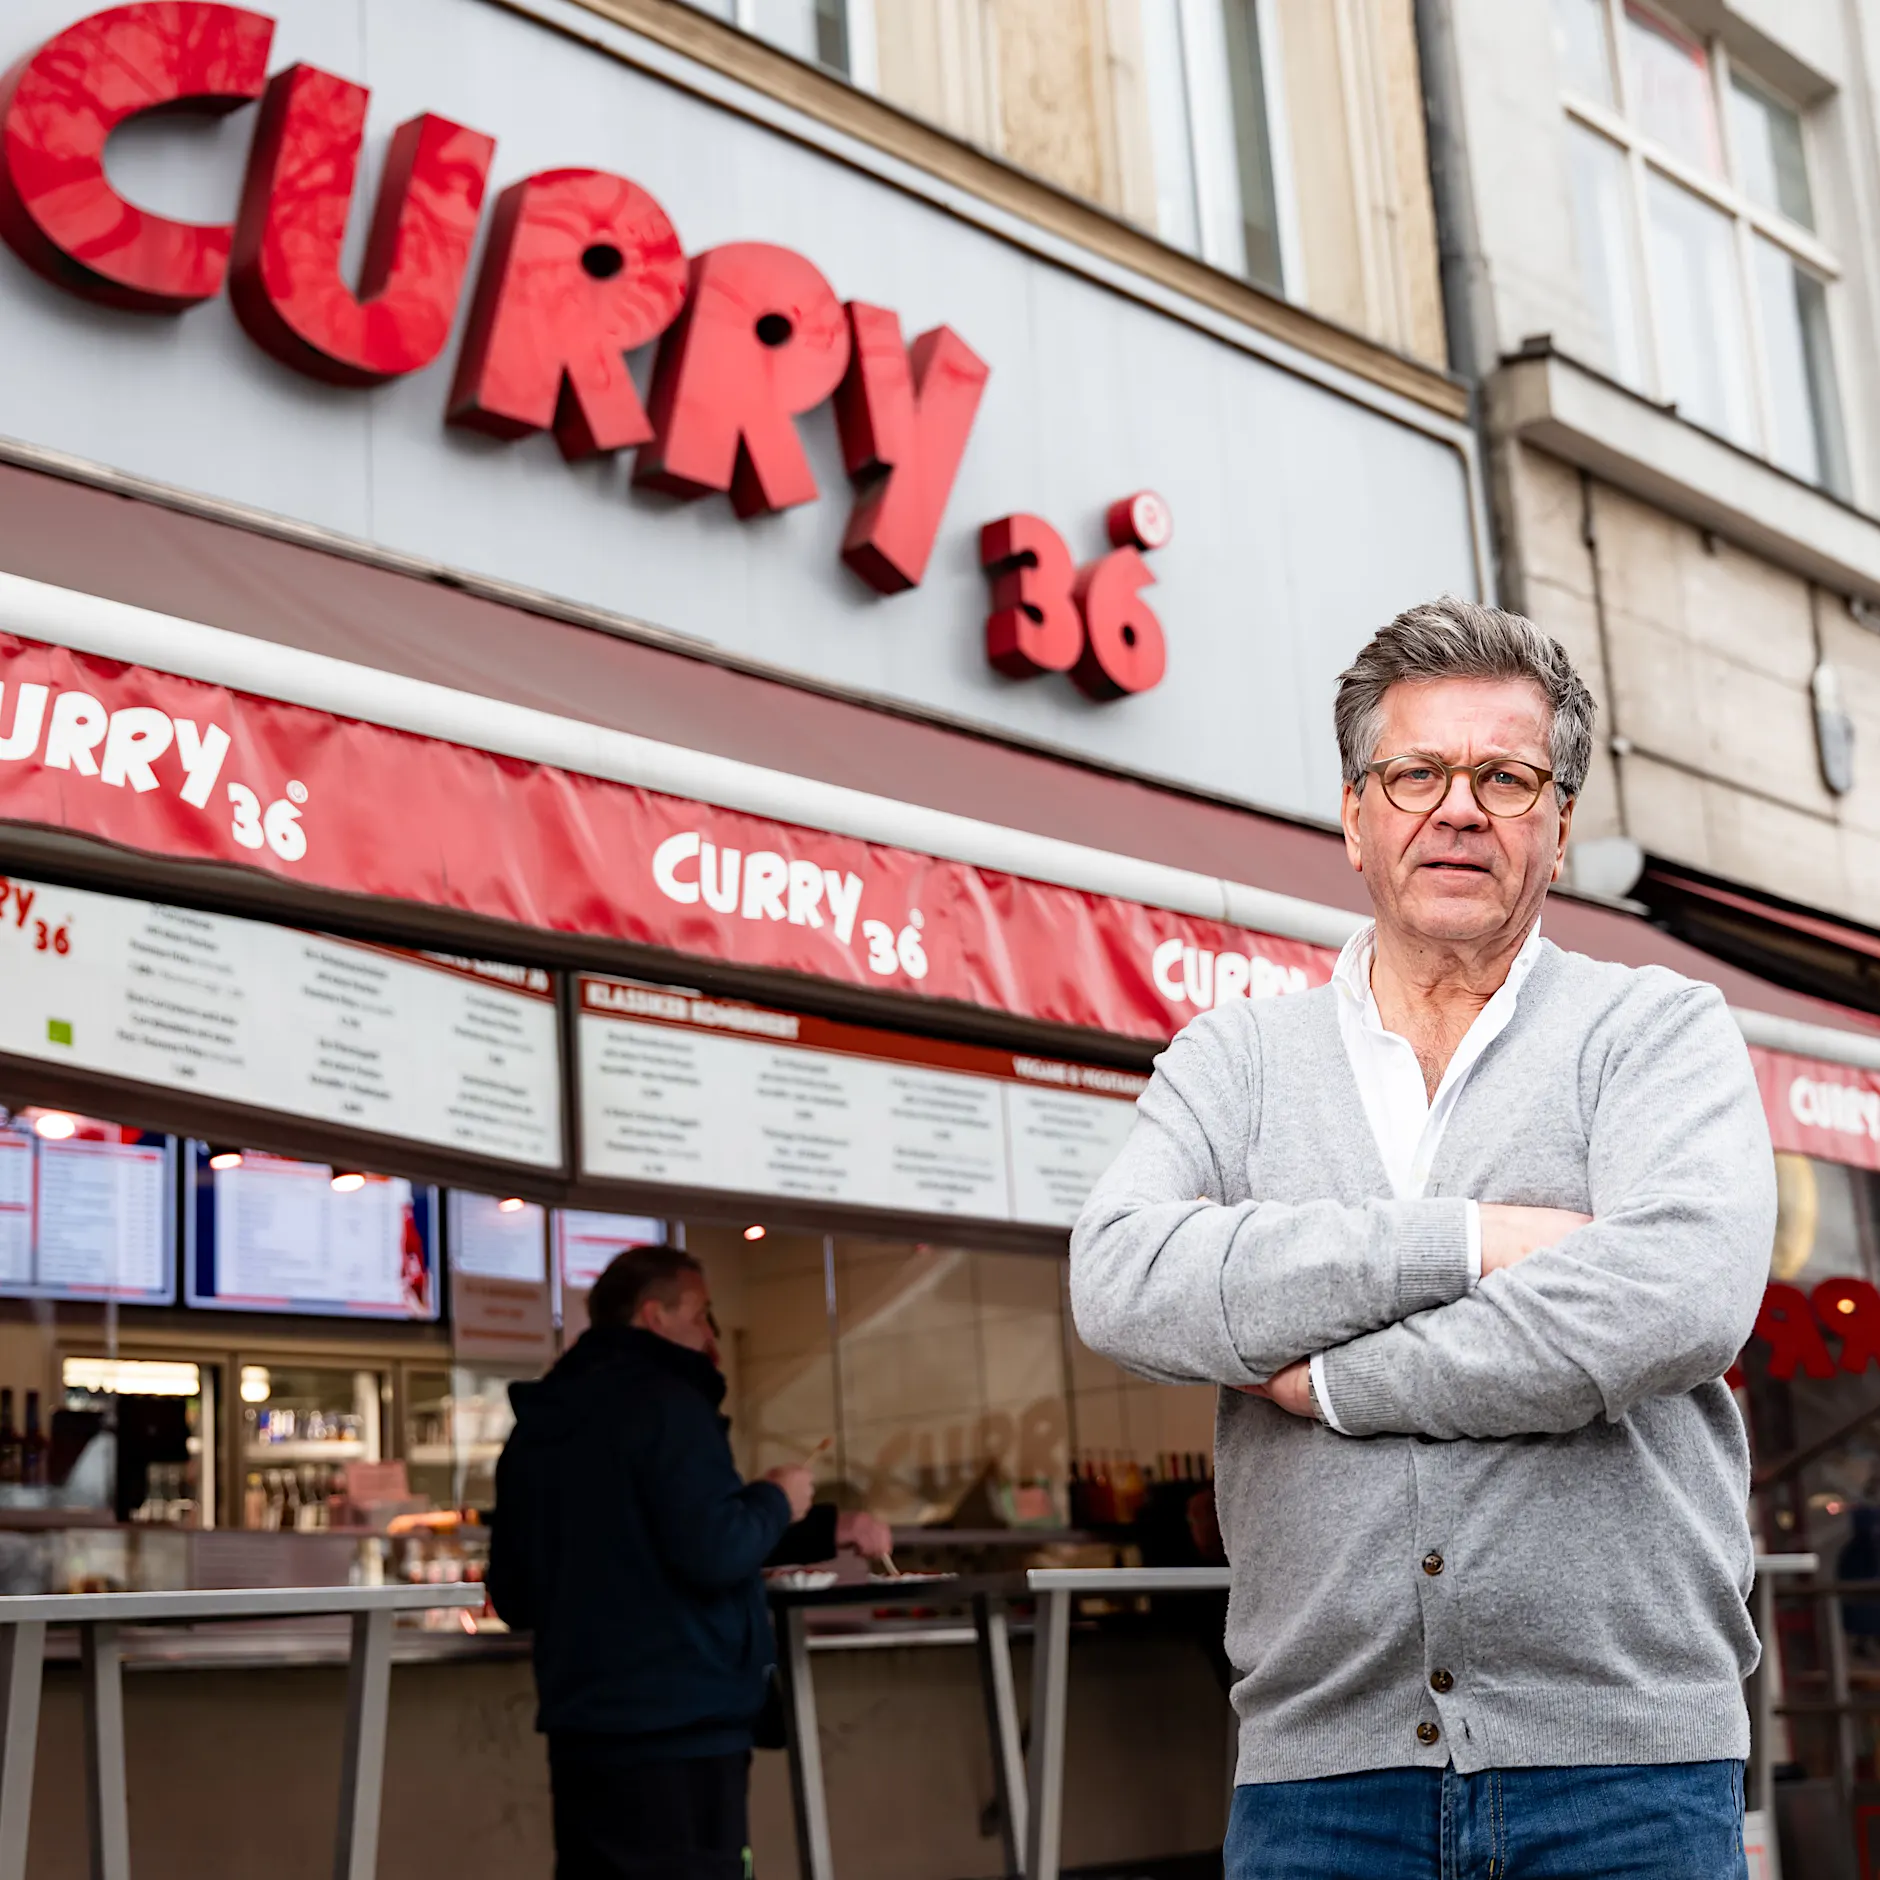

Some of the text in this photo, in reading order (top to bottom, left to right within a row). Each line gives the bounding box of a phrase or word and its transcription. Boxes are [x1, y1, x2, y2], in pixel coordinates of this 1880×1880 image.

[2, 0, 990, 596] CURRY
[227, 782, 307, 861] 36
[35, 918, 70, 954] 36
[652, 831, 928, 979] CURRY 36
